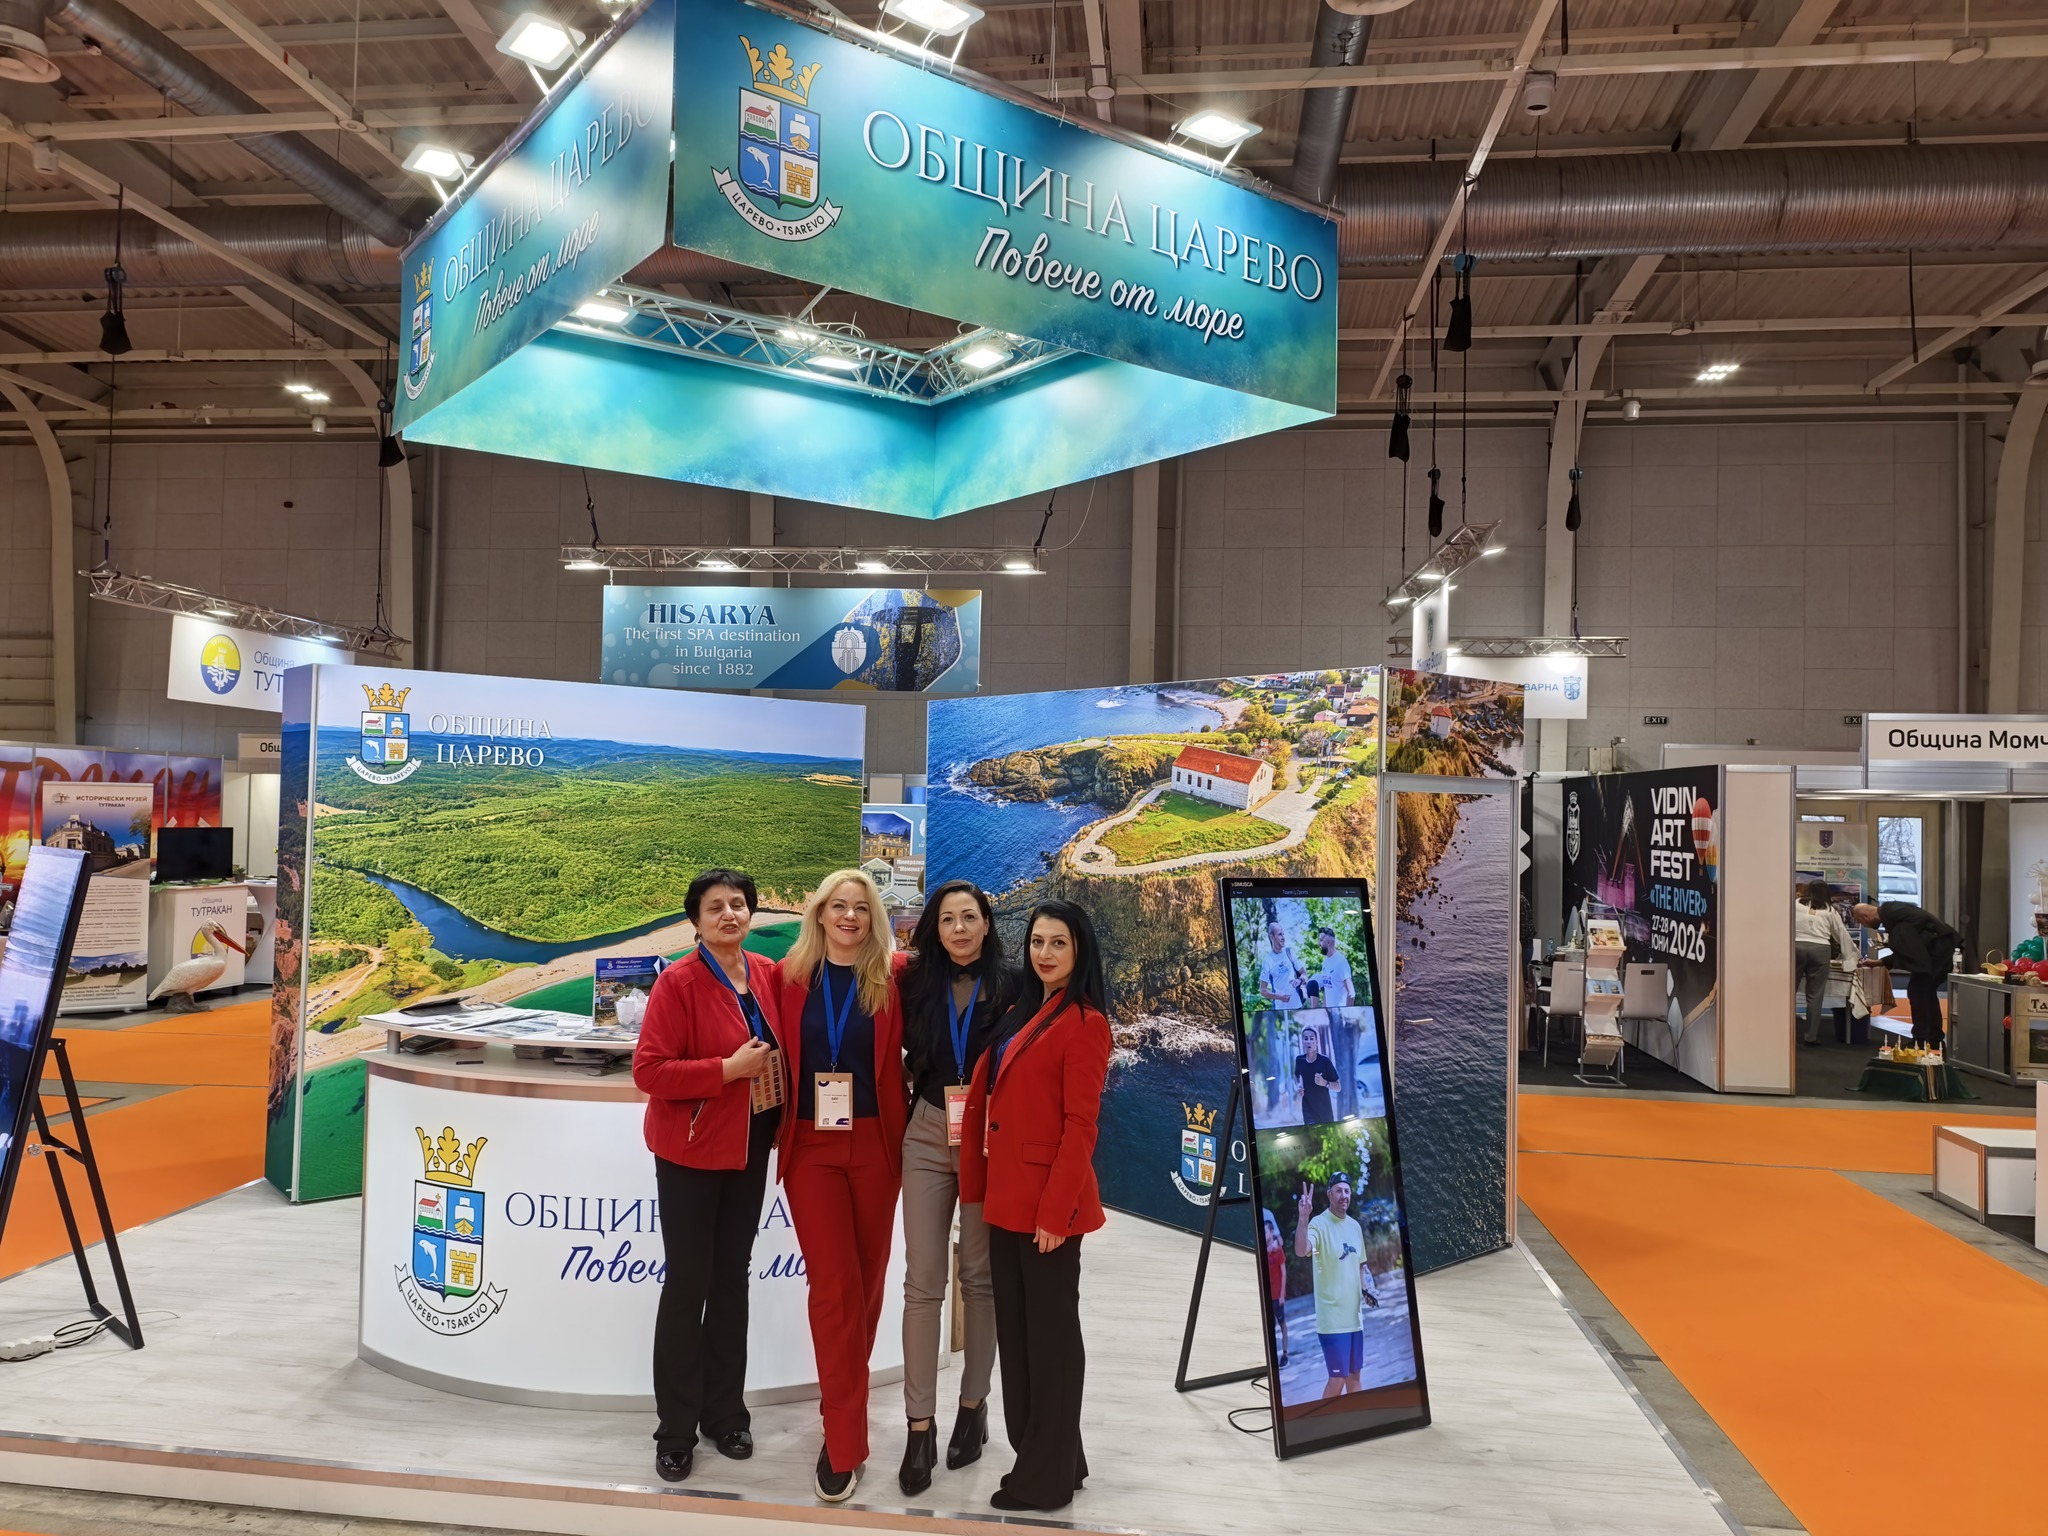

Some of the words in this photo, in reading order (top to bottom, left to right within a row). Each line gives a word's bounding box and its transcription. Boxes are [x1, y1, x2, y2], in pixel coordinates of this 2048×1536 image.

[444, 178, 542, 303] ОБЩИНА
[550, 72, 658, 213] ЦАРЕВО
[732, 192, 774, 231] ЦАРЕВО
[863, 110, 1136, 245] ОБЩИНА
[1149, 203, 1324, 301] ЦАРЕВО
[783, 215, 825, 235] TSAREVO
[474, 269, 525, 337] Повече
[527, 251, 551, 294] от
[552, 210, 600, 272] море
[975, 226, 1102, 299] Повече
[1110, 279, 1158, 316] от
[1163, 295, 1245, 345] море
[647, 603, 778, 626] HISARYA
[624, 627, 650, 640] The
[655, 627, 682, 640] first
[687, 628, 715, 641] SPA
[719, 630, 801, 642] destination
[254, 651, 295, 668] Община
[675, 645, 688, 657] in
[694, 646, 752, 661] Bulgaria
[672, 662, 711, 675] since
[718, 664, 754, 676] 1882
[428, 713, 552, 742] ОБЩИНА
[1645, 716, 1666, 724] EXIT
[1888, 729, 1982, 751] Община
[437, 743, 544, 769] ЦАРЕВО
[356, 766, 381, 782] ЦАРЕВО
[386, 766, 412, 782] TSAREVO
[1650, 786, 1697, 815] VIDIN
[1650, 819, 1685, 847] ART
[1650, 849, 1695, 881] FEST
[191, 904, 232, 917] ТУТРАКАН
[1651, 914, 1669, 934] 27-28
[1669, 919, 1706, 963] 2026
[1651, 932, 1669, 954] ЮНИ
[407, 1288, 439, 1326] ЦАРЕВО
[446, 1303, 488, 1329] TSAREVO
